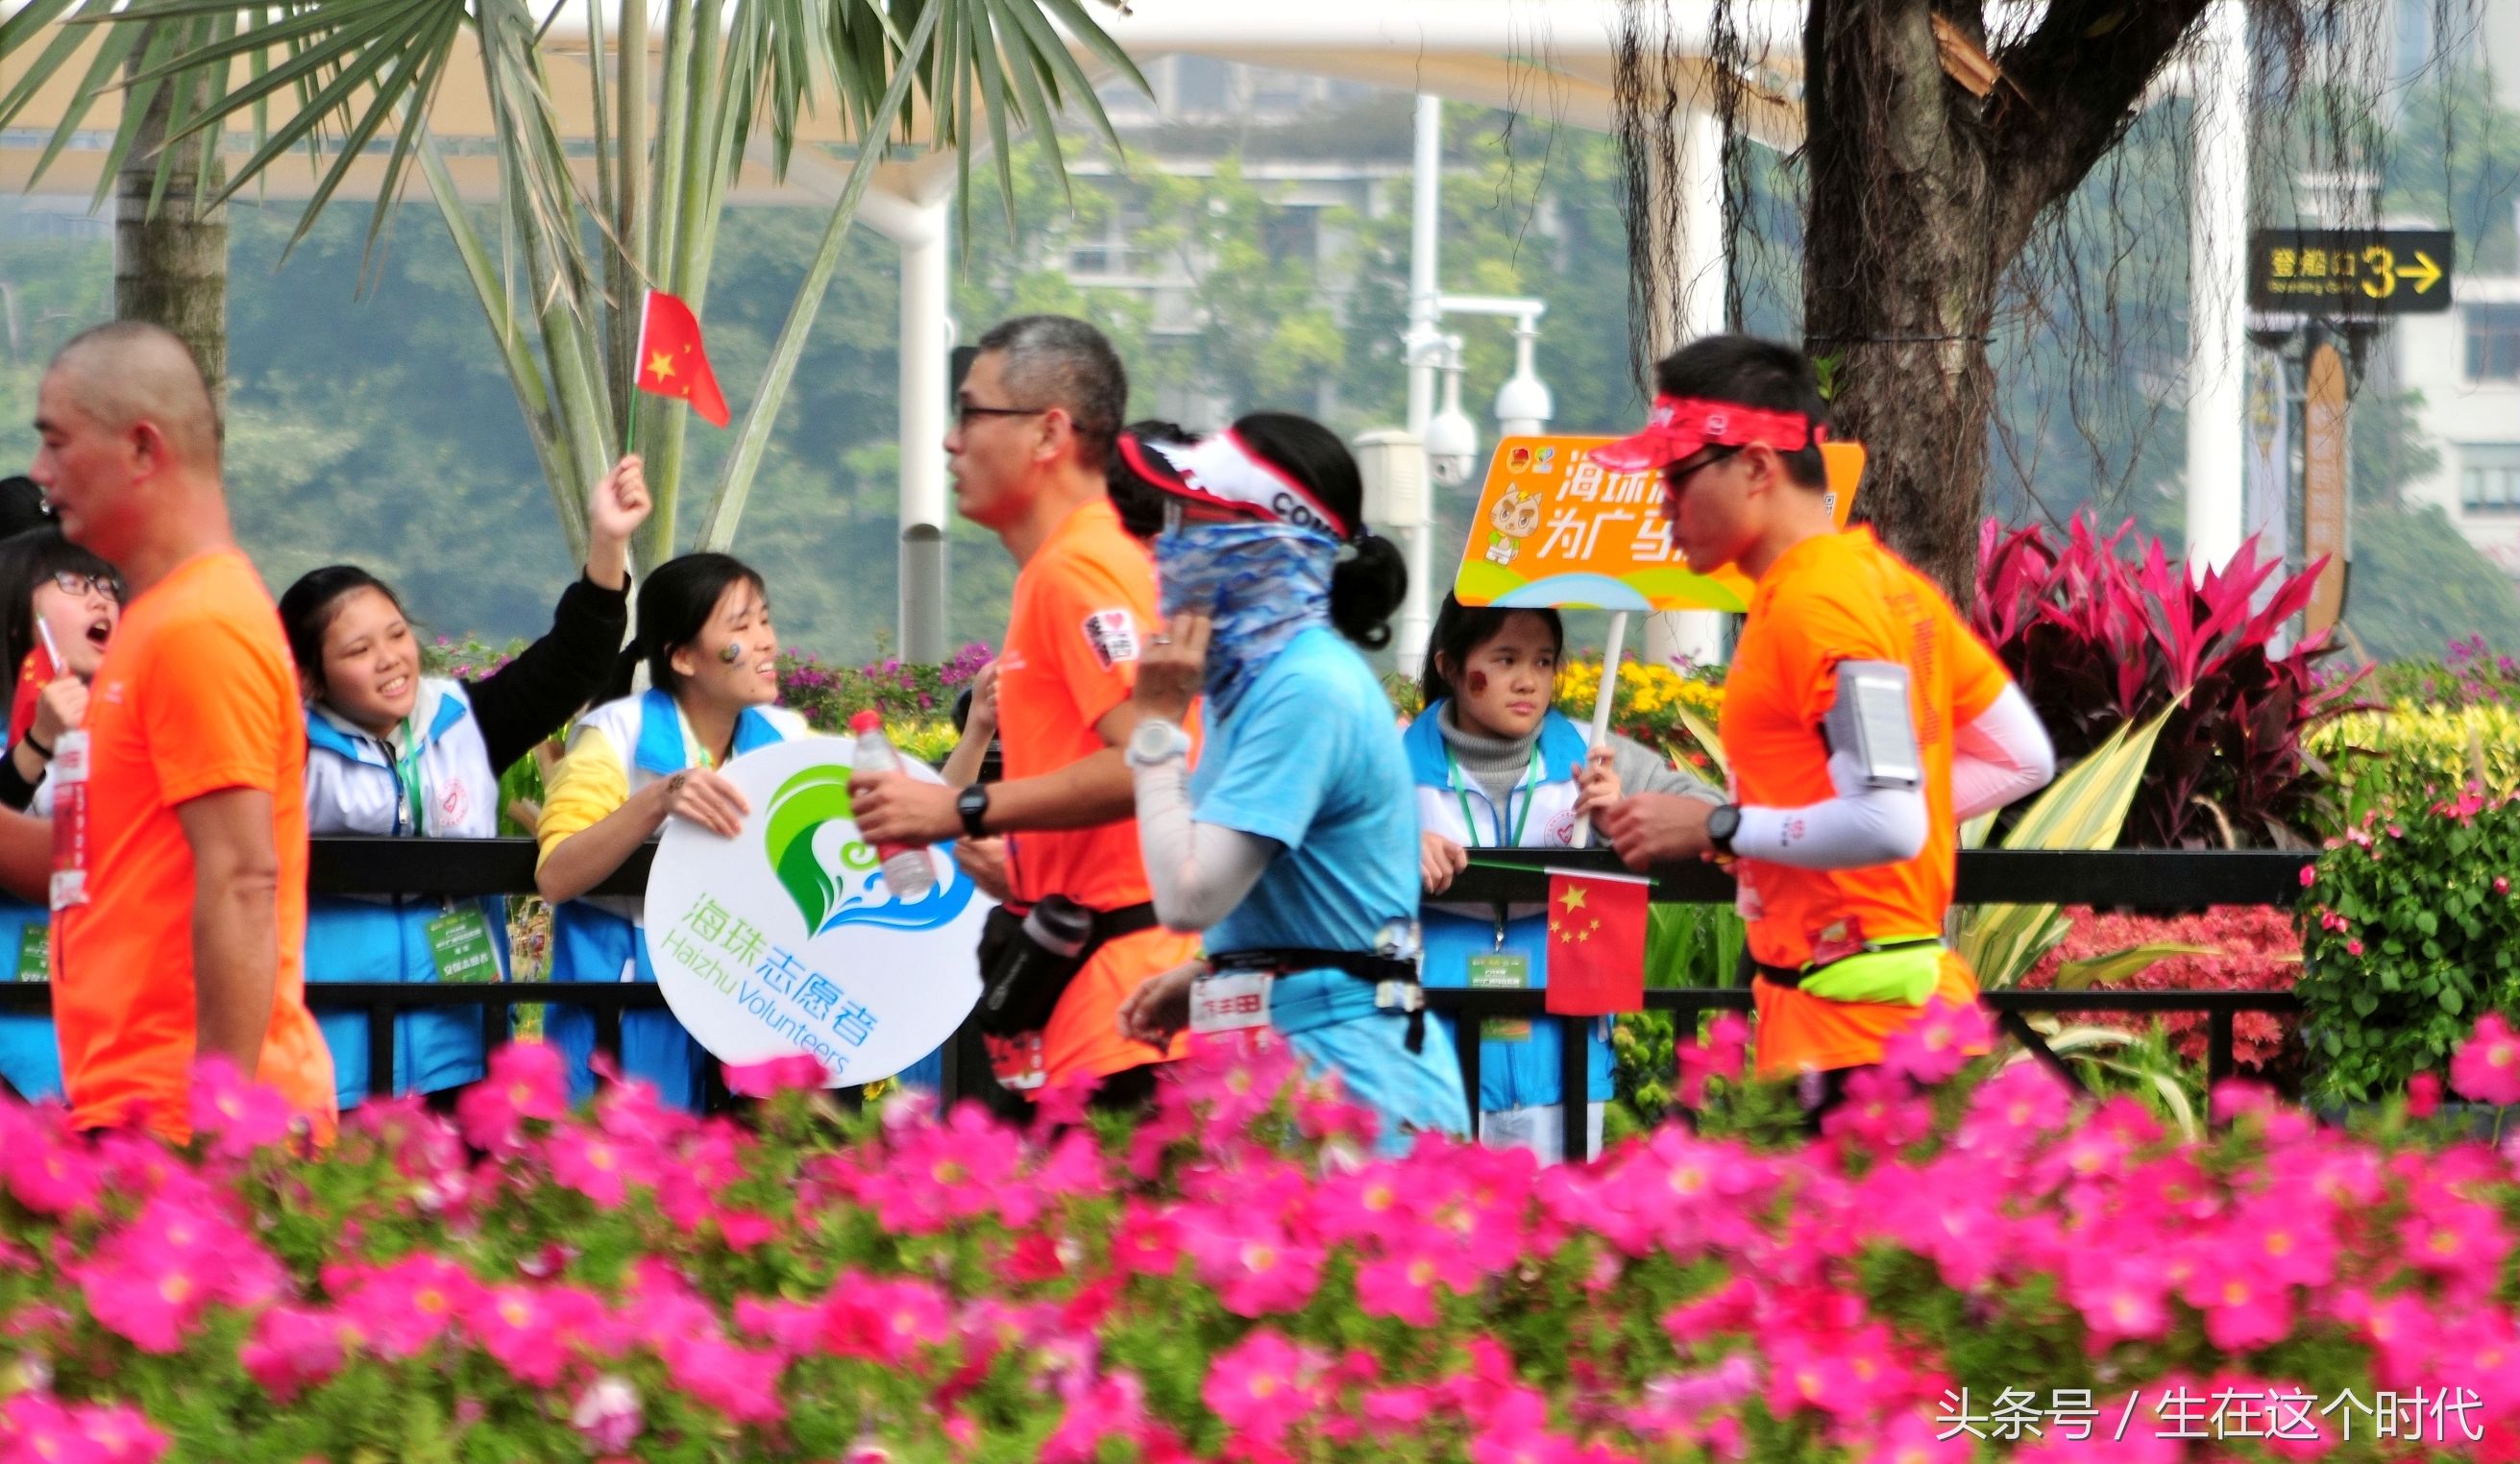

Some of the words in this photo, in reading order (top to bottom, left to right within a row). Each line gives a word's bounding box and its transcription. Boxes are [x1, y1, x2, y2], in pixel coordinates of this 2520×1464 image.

[2361, 246, 2396, 298] 3
[1536, 507, 1689, 561] 为广马
[660, 928, 739, 997] Haizhu
[737, 981, 851, 1076] Volunteers
[681, 891, 878, 1047] 海珠志愿者
